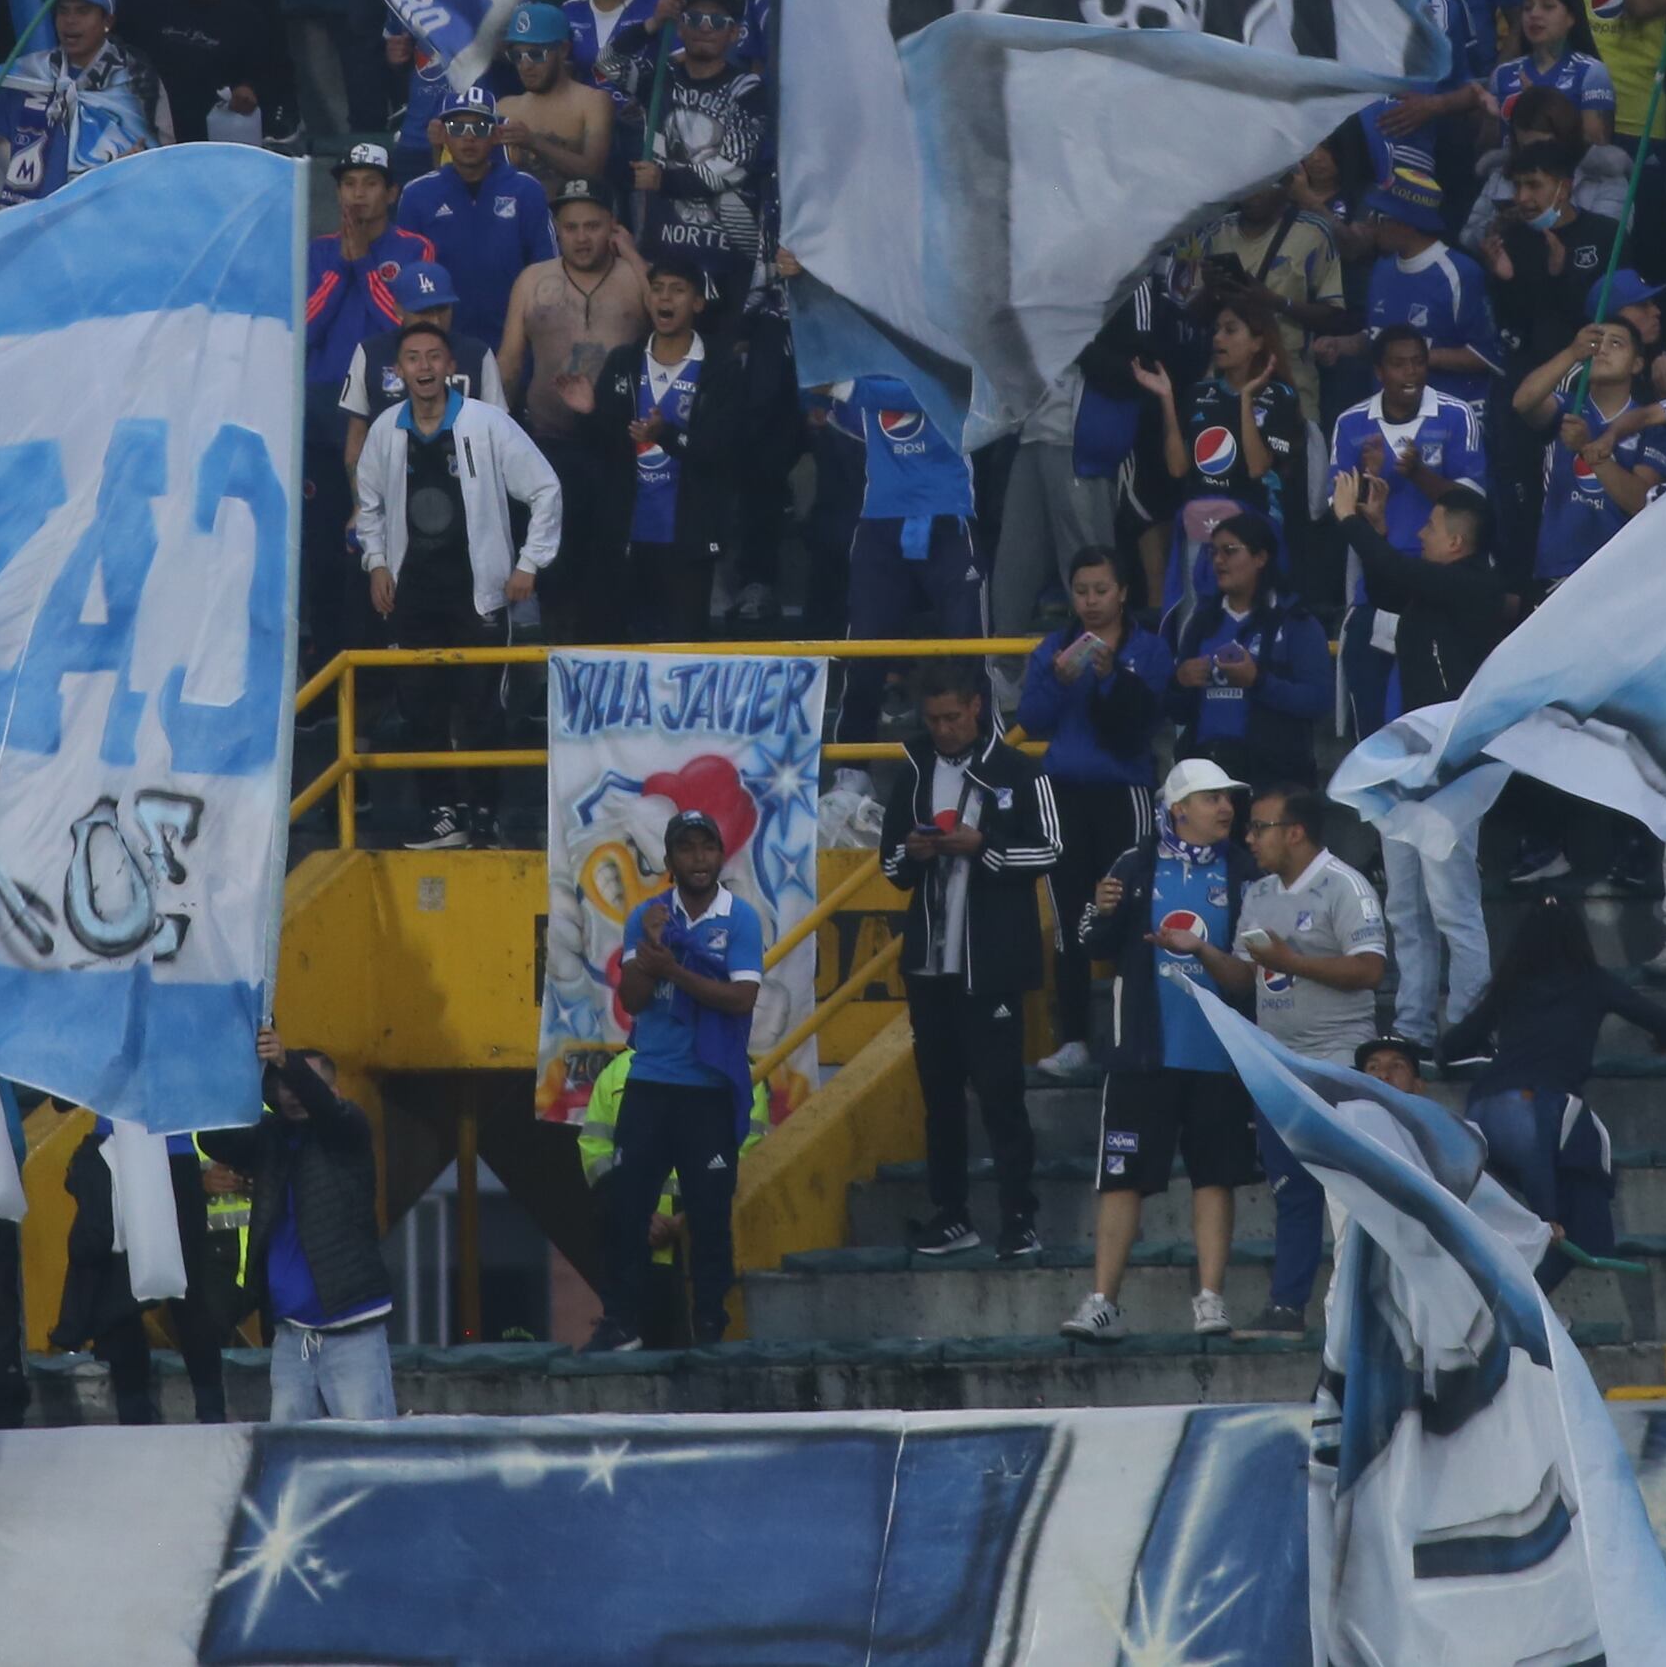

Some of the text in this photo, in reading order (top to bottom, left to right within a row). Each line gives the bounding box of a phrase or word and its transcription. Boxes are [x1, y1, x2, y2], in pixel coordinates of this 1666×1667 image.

[661, 223, 733, 252] NORTE
[551, 655, 818, 735] VILLA JAVIER
